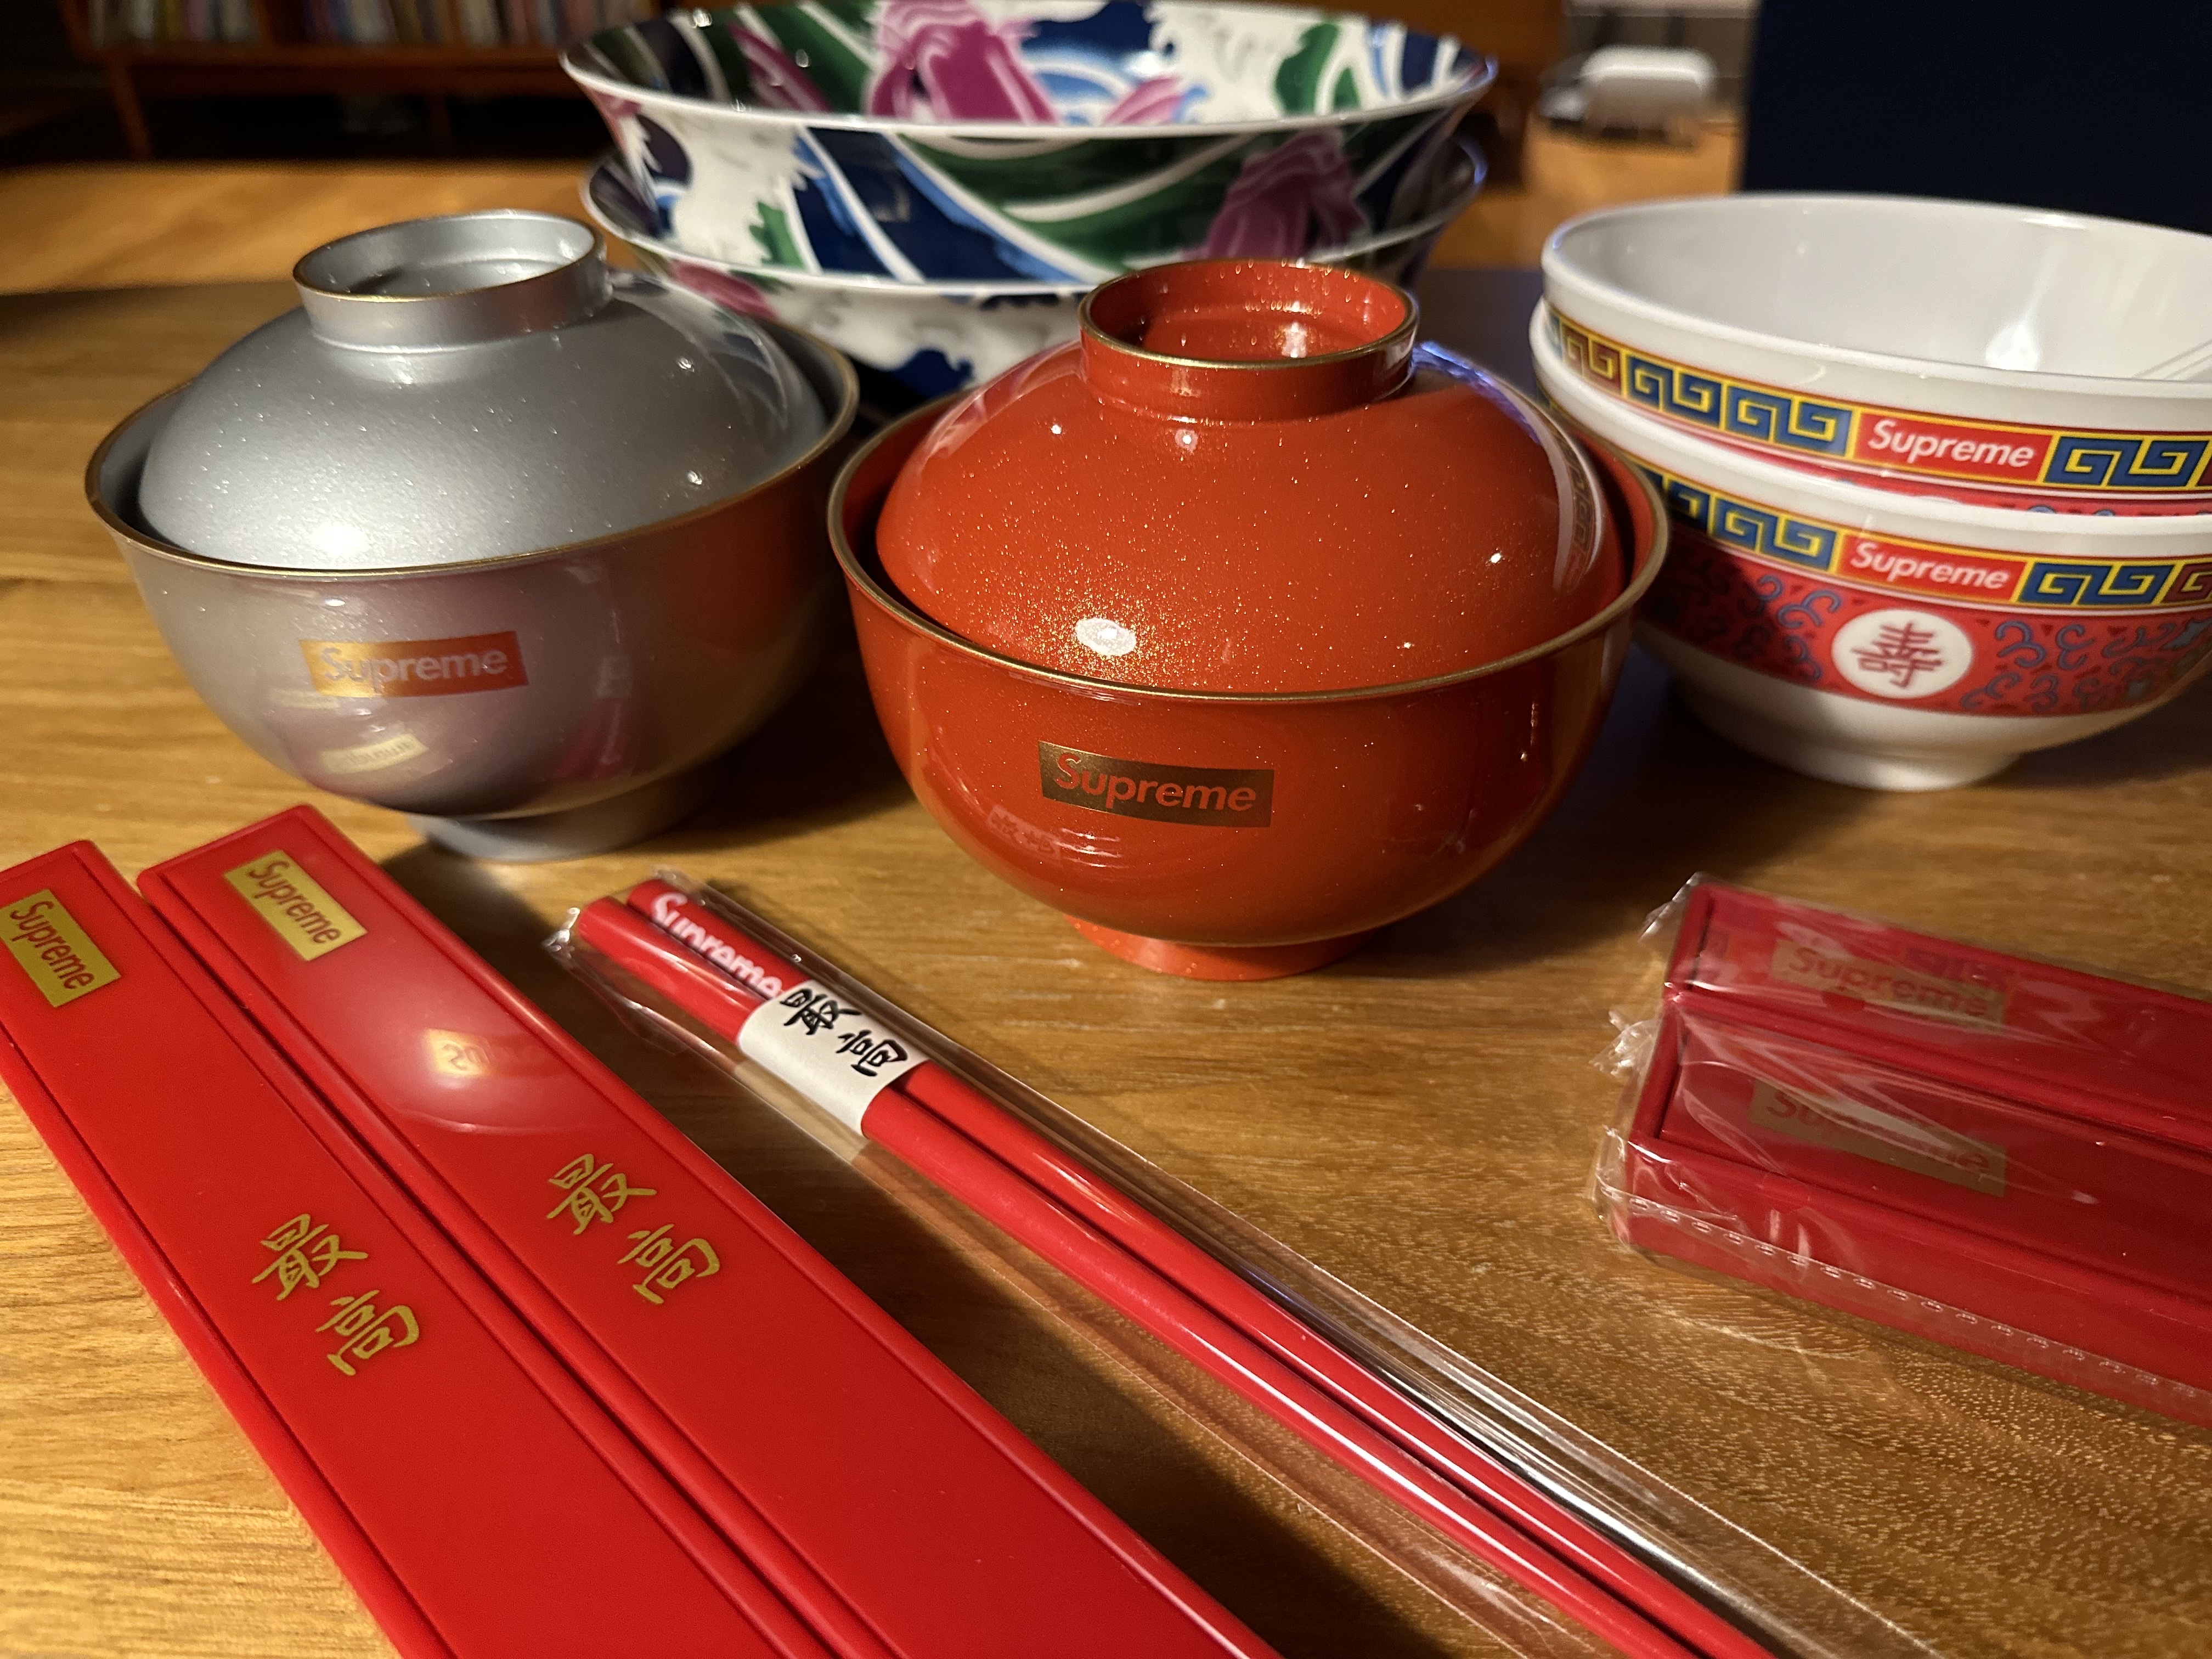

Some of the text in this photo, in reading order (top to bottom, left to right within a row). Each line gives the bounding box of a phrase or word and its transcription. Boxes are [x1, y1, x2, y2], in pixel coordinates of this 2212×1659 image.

[1868, 419, 2035, 467] Supreme
[1850, 541, 2010, 589] Supreme
[320, 646, 509, 693] Supreme
[1055, 752, 1256, 811] Supreme
[9, 900, 95, 990] Supreme
[249, 860, 342, 945] Supreme
[779, 988, 909, 1077] 最高
[546, 1153, 721, 1305] 最高
[251, 1213, 420, 1376] 最高
